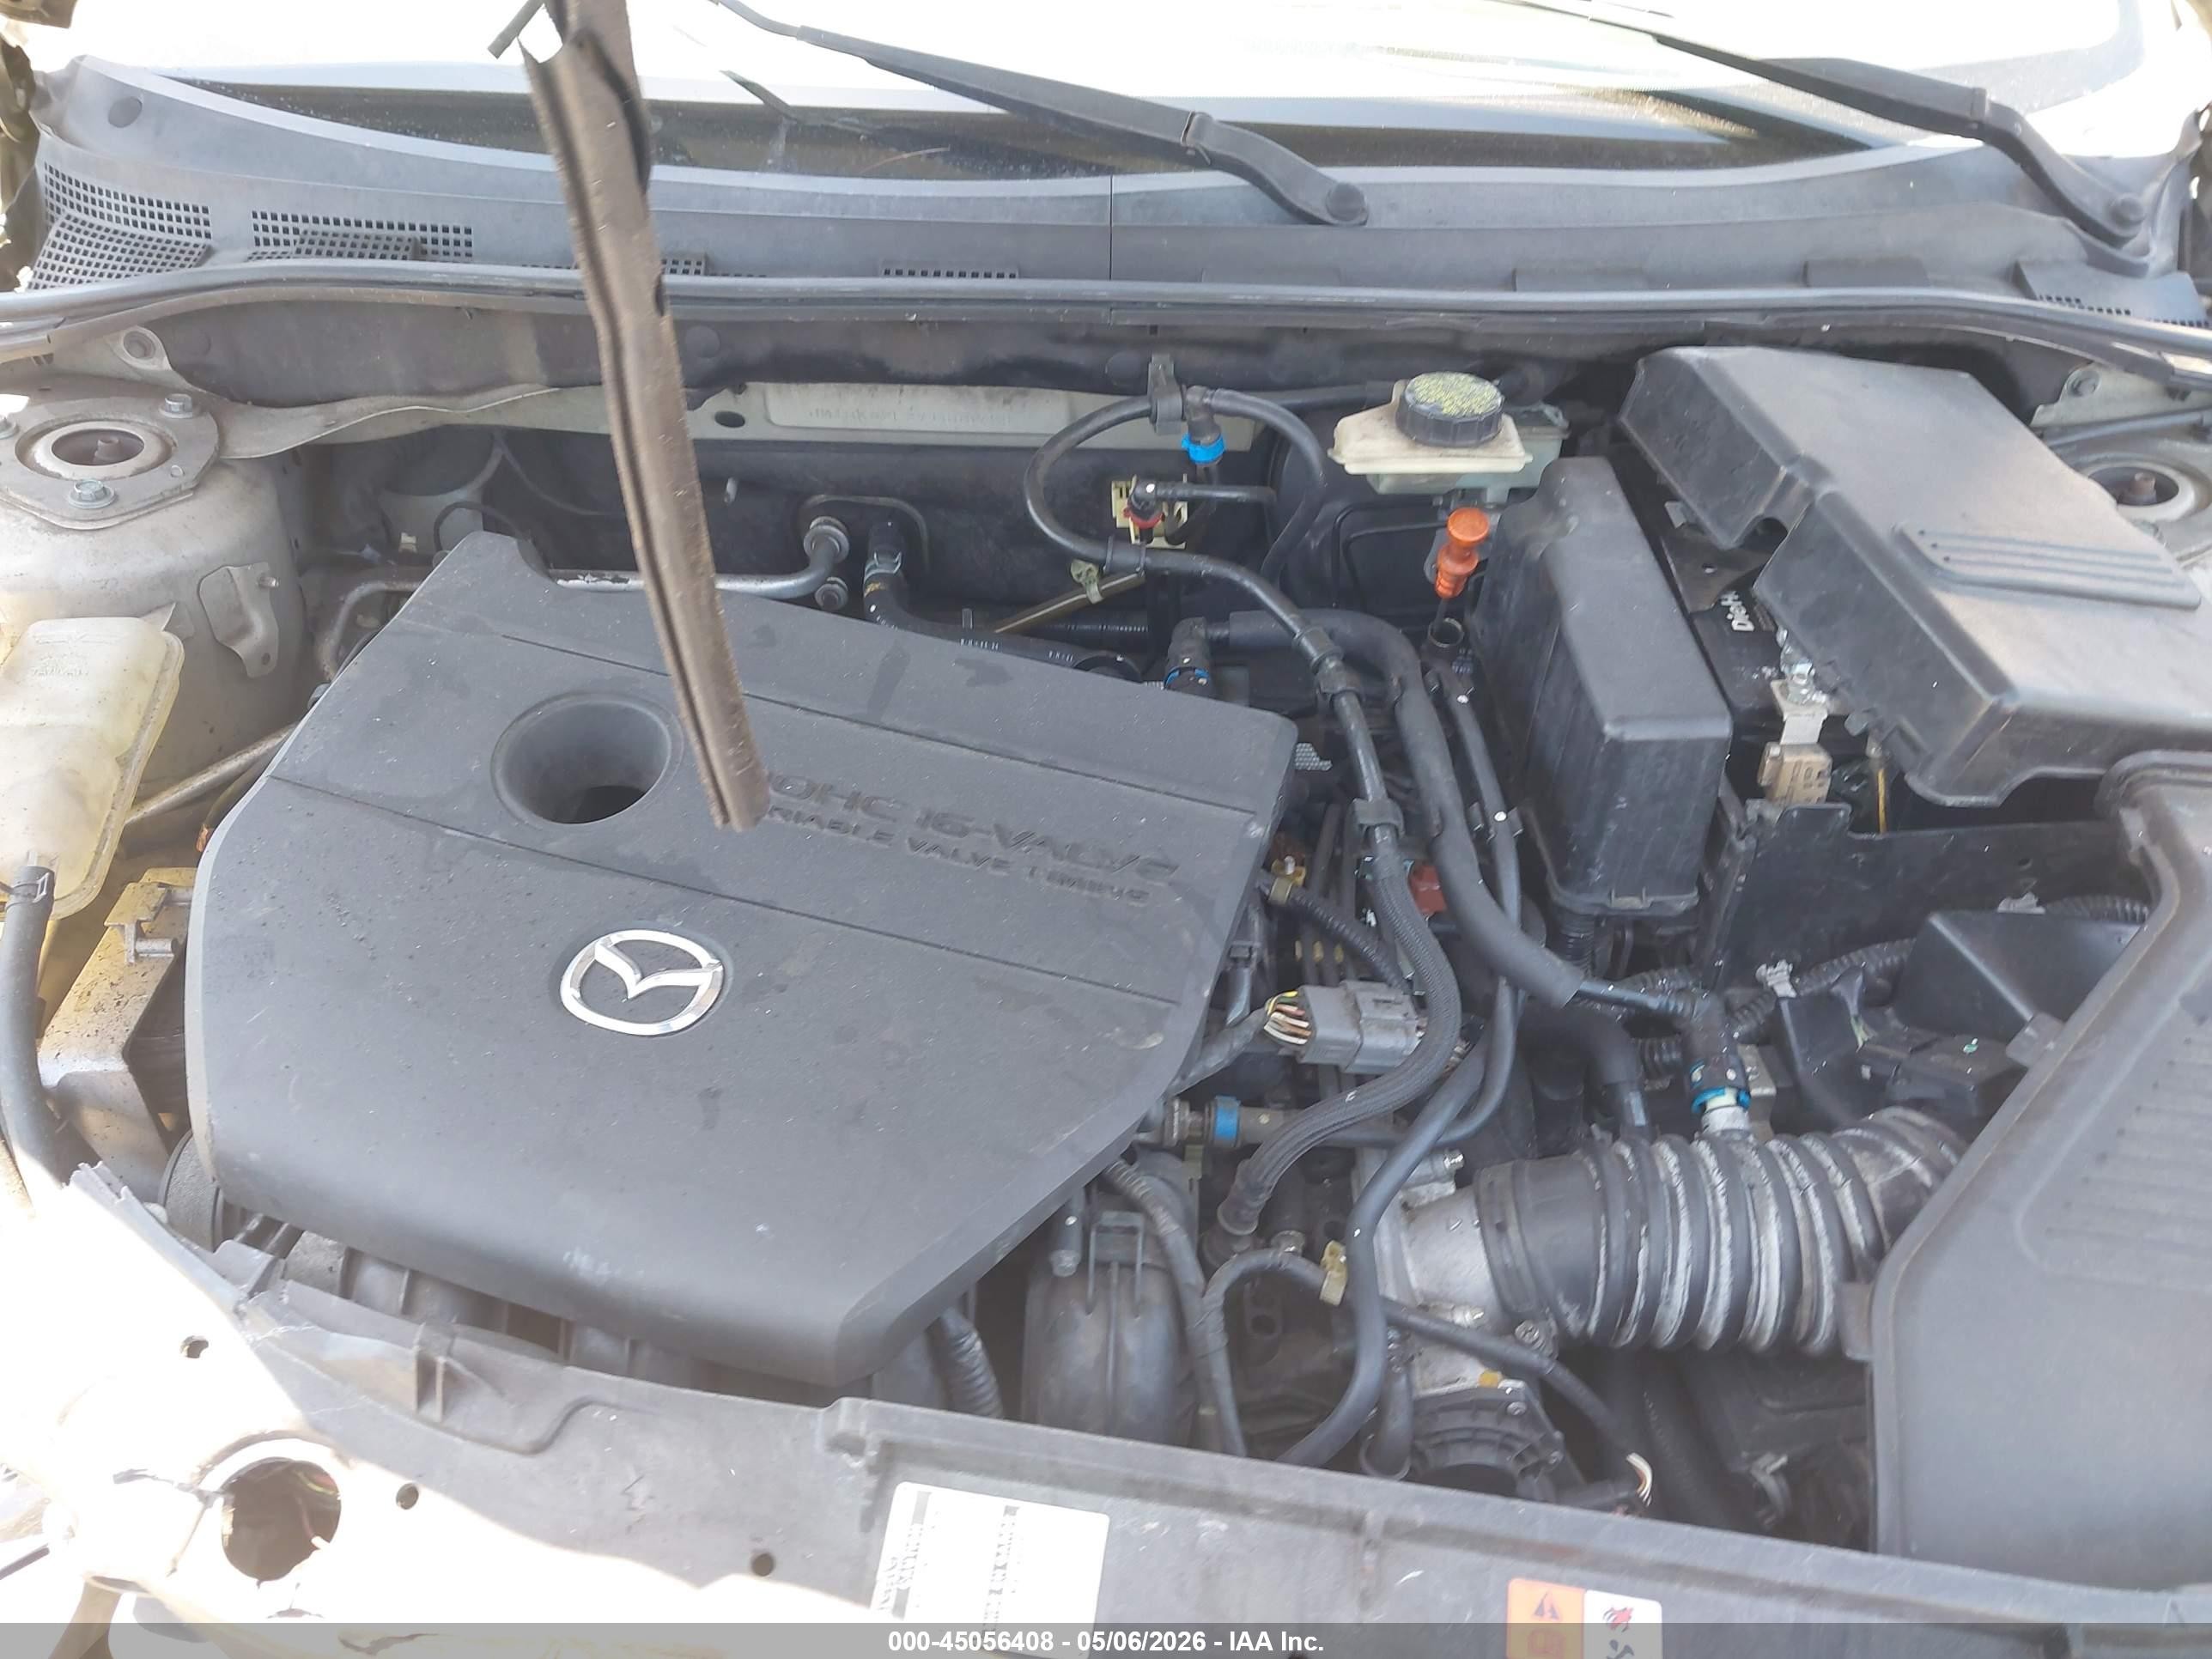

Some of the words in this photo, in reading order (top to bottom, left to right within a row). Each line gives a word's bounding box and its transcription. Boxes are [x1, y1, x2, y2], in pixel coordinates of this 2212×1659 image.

[770, 773, 903, 823] OHC
[769, 805, 895, 843] RIABLE
[907, 836, 1012, 872] VALVE
